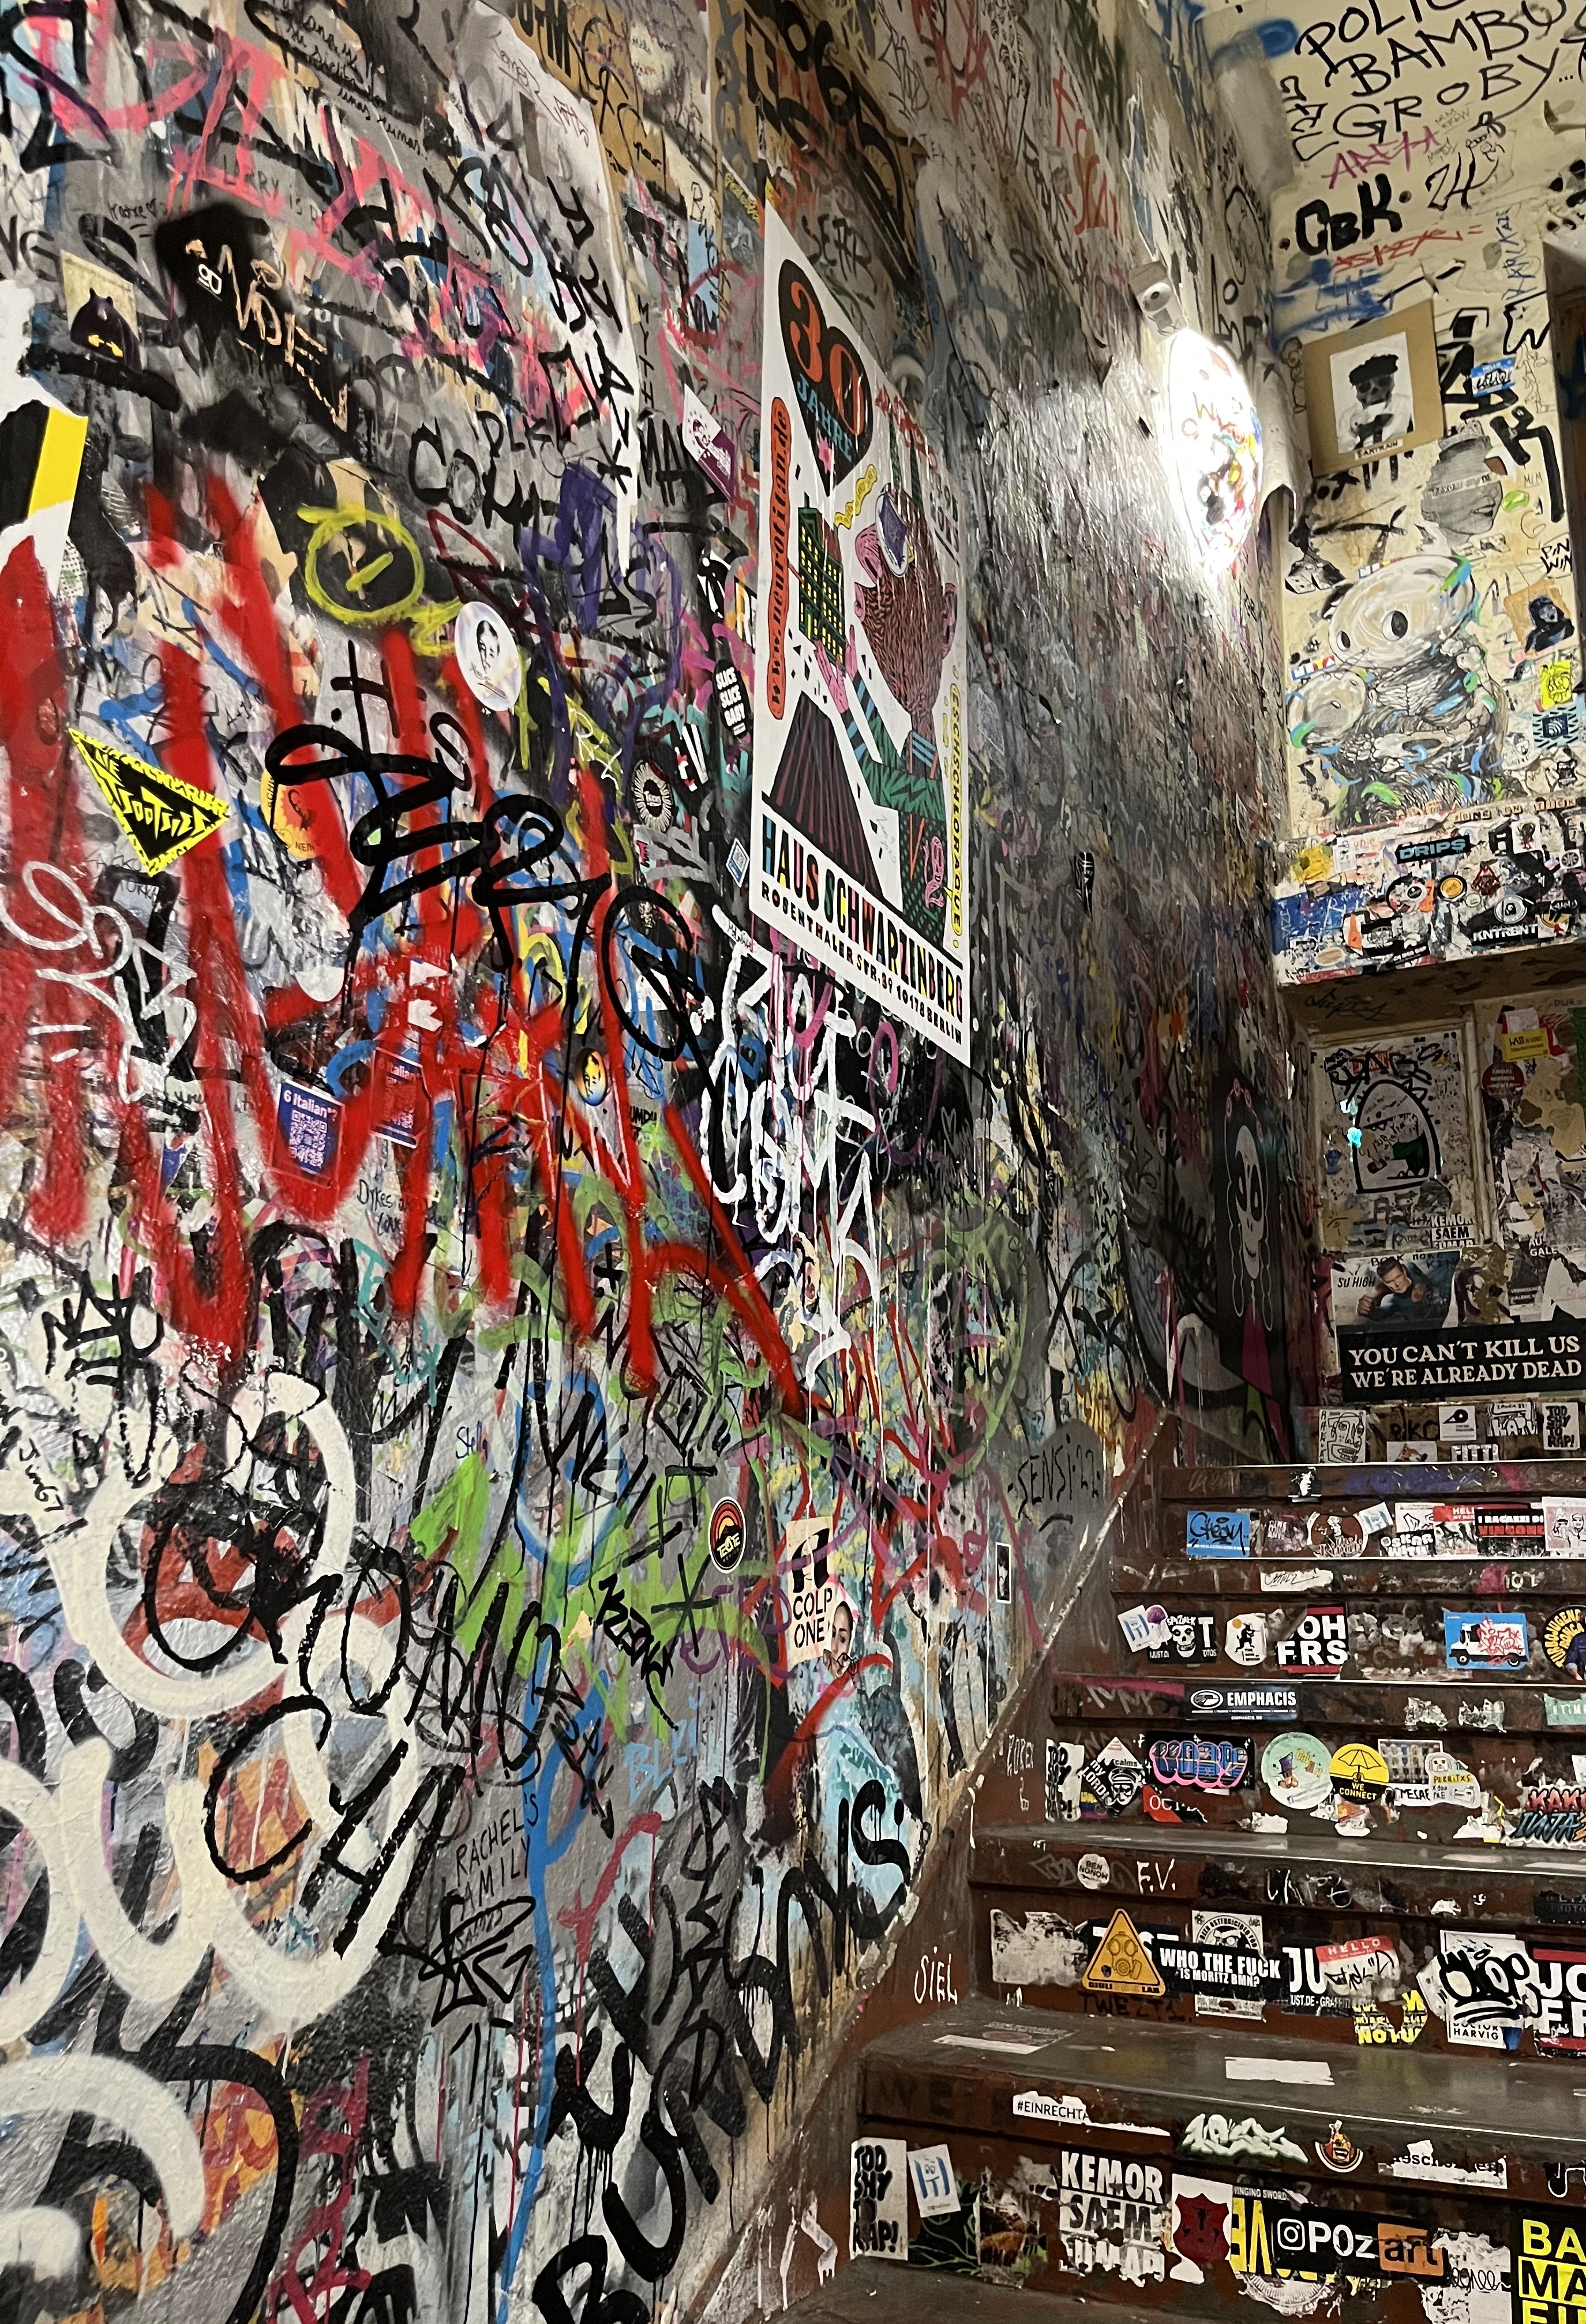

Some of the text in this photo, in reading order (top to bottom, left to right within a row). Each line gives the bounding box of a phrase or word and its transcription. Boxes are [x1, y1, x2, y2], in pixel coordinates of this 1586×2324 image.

[790, 280, 864, 437] 30
[797, 371, 852, 462] JAHRE
[715, 666, 737, 691] SLICE
[720, 687, 742, 709] SLICE
[724, 703, 746, 727] BABY
[1398, 838, 1467, 861] DRIPS
[762, 813, 963, 1023] HAUS SCHWARZENBERG
[762, 881, 853, 964] ROSENTHALER
[897, 985, 925, 1018] 10178
[927, 1009, 962, 1045] BERLIN
[283, 1089, 292, 1103] 6
[1435, 1226, 1470, 1240] SAEM
[1352, 1275, 1377, 1288] HIGH
[1349, 1347, 1397, 1366] YOU
[1484, 1338, 1544, 1358] KILL
[1547, 1336, 1581, 1354] US
[1420, 1363, 1520, 1386] ALREADY
[1523, 1360, 1583, 1380] DEAD
[793, 1587, 833, 1619] COLP
[793, 1623, 826, 1649] ONE
[1288, 1615, 1347, 1640] OH
[1277, 1640, 1349, 1666] FRS
[1227, 1691, 1296, 1707] EMPHACIS
[1115, 1758, 1138, 1768] calms
[1338, 1788, 1378, 1801] CONNECT
[1351, 1782, 1366, 1791] WE
[461, 1835, 531, 1908] AMILY
[1085, 1860, 1103, 1871] BEN
[1327, 1937, 1382, 1957] HELLO
[1159, 1947, 1281, 1980] WHO THE FUCK
[1180, 1968, 1191, 1980] IS
[1191, 1970, 1230, 1985] MORITZ
[1453, 2027, 1499, 2041] HARVIG
[1061, 2151, 1164, 2204] KEMOR
[1068, 2194, 1153, 2242] SAEM
